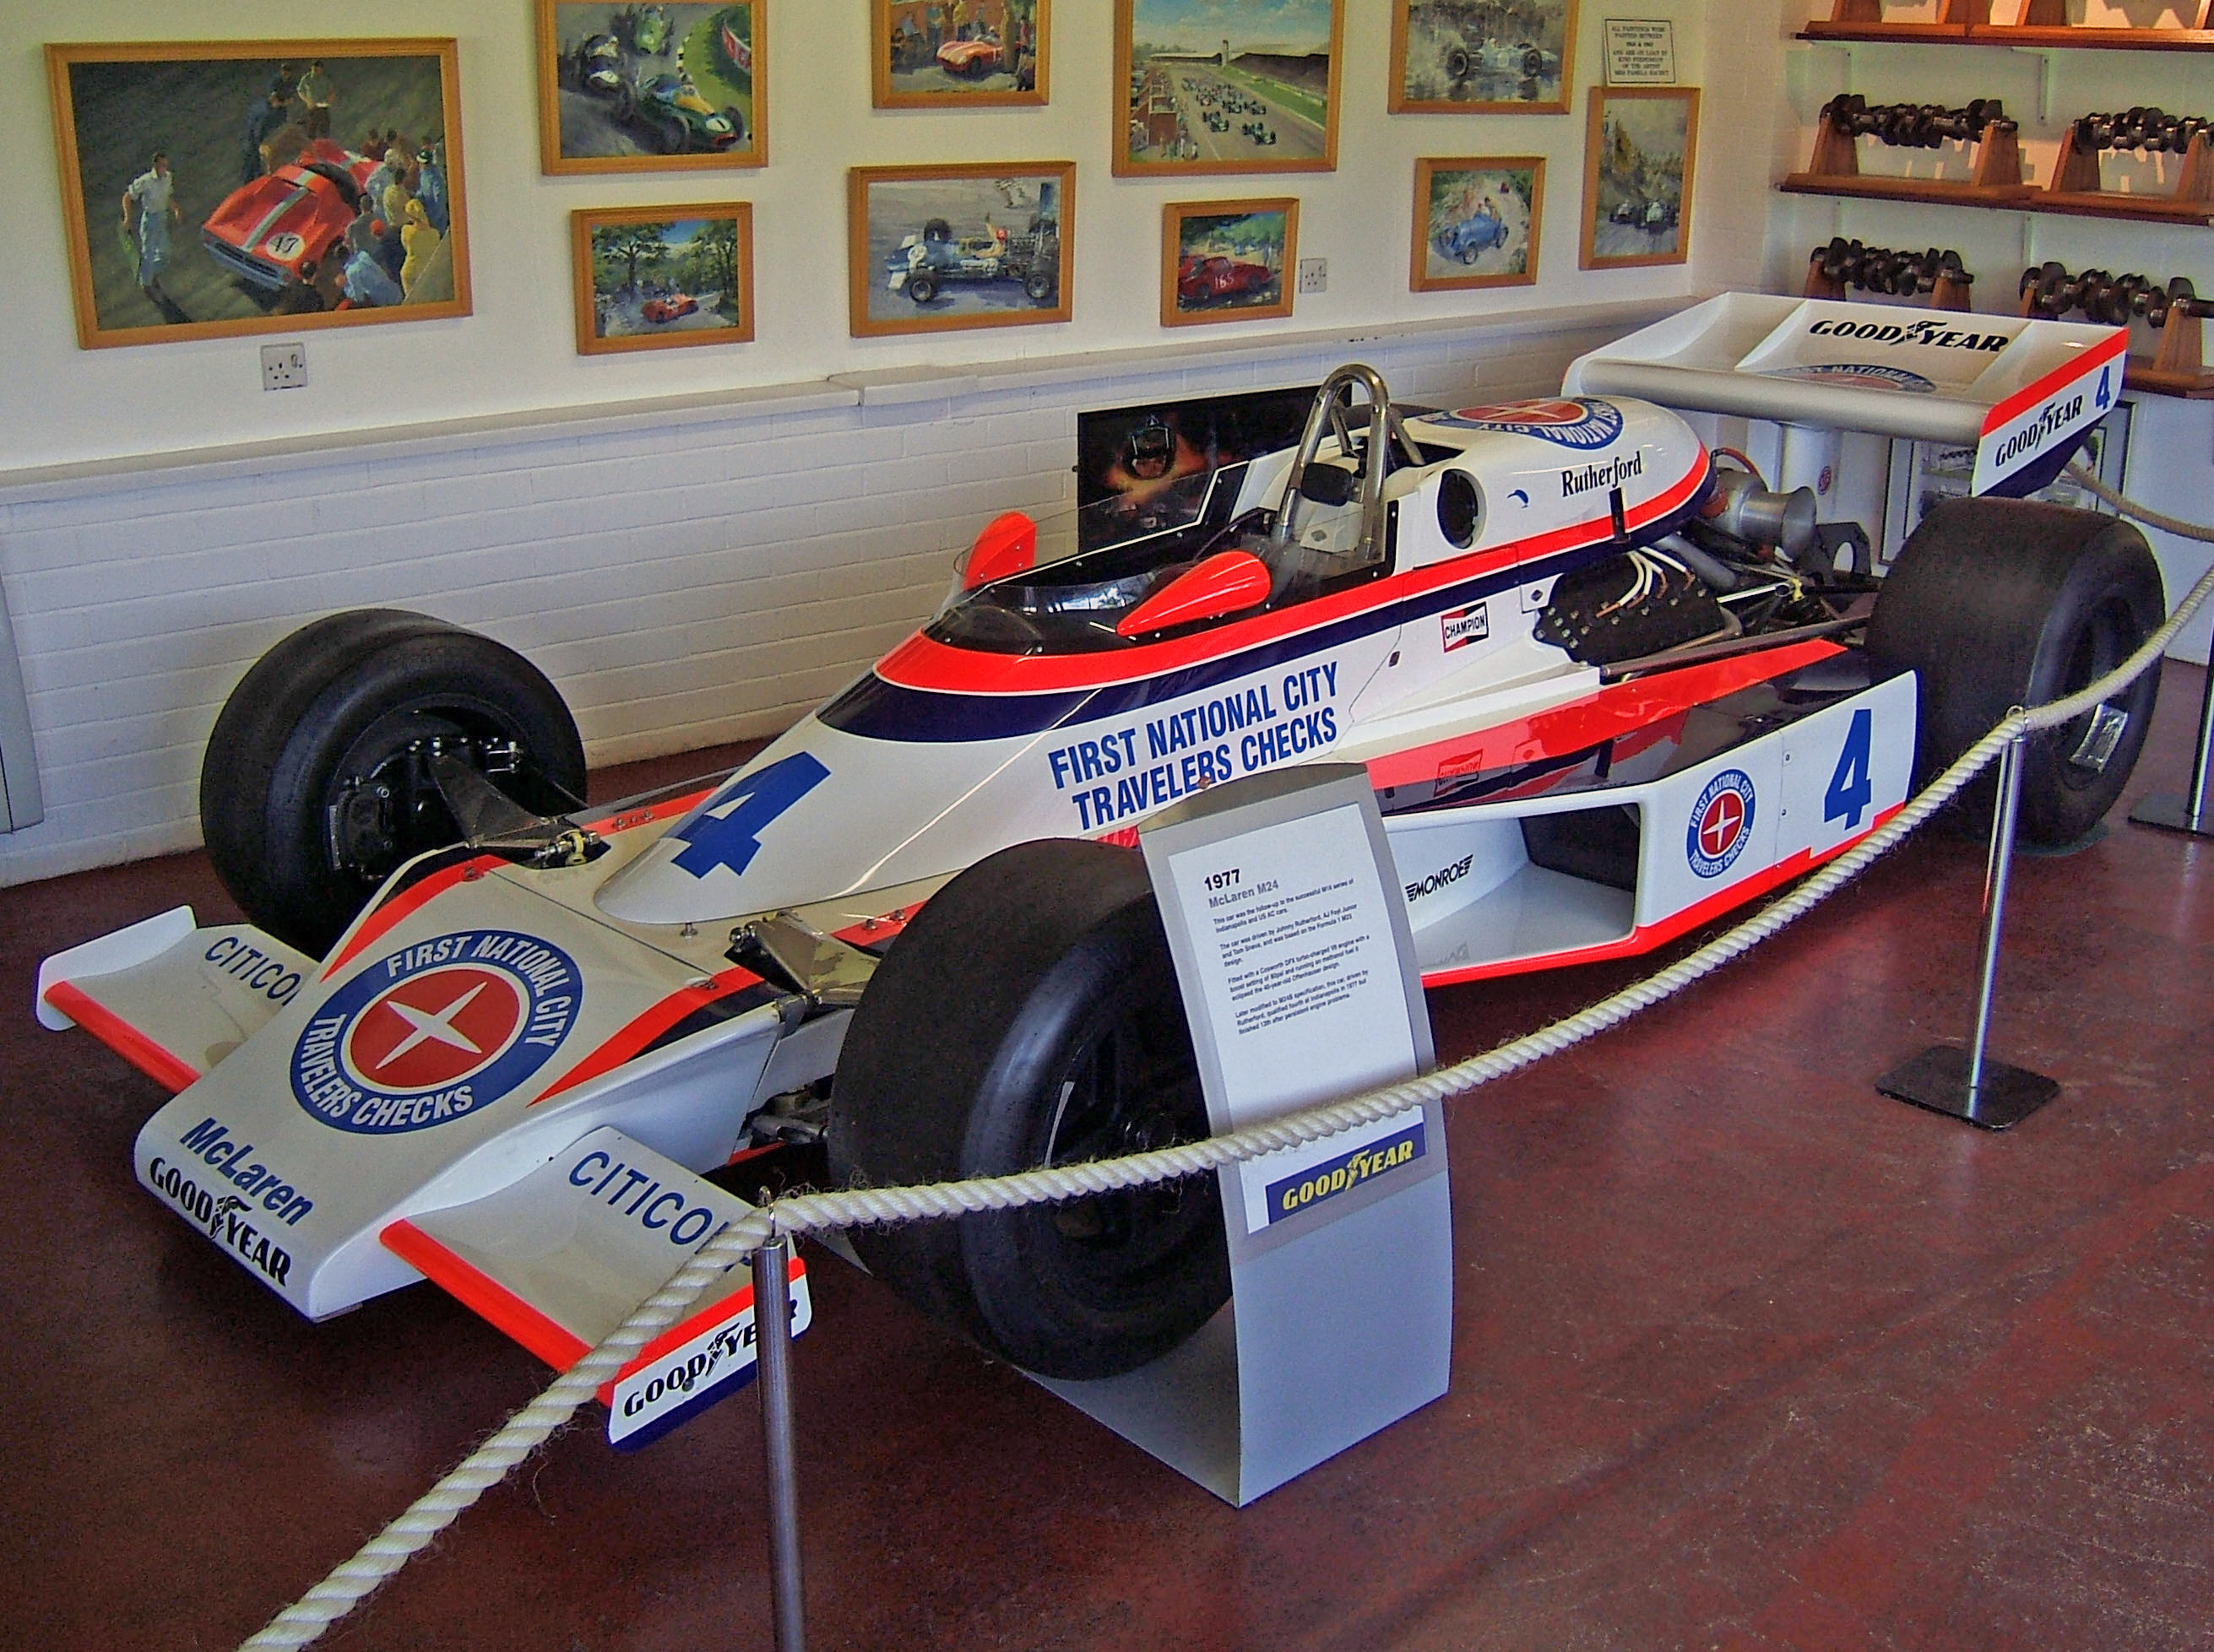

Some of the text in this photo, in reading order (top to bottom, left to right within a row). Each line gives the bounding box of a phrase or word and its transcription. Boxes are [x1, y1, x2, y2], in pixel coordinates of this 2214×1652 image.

[1810, 321, 2009, 352] GOODYEAR
[2096, 366, 2110, 410] 4
[1995, 395, 2082, 467] GOODYEAR
[1561, 450, 1642, 497] Rutherford
[1445, 615, 1485, 639] CHAMPION
[1048, 661, 1338, 789] FIRST NATIONAL CITY
[1072, 707, 1338, 830] TRAVELERS CHECKS
[1690, 794, 1708, 828] FIRST
[1739, 780, 1753, 803] CITY
[1824, 708, 1871, 831] 4
[670, 751, 832, 880] 4
[1723, 826, 1750, 867] CHECKS
[1204, 868, 1240, 891] 1977
[1209, 880, 1279, 908] McLaren M24
[1405, 854, 1473, 902] MONROE
[1216, 920, 1247, 934] Indianapolis
[1258, 913, 1267, 921] US
[1222, 951, 1232, 959] and
[1251, 931, 1267, 941] driven
[204, 936, 302, 1007] CITICO
[387, 935, 572, 1047] FIRST NATIONAL CITY
[301, 1014, 474, 1127] TRAVELERS CHECKS
[179, 1117, 313, 1227] McLaren
[1283, 1140, 1414, 1211] GOODYEAR
[149, 1156, 291, 1286] GOODYEAR
[568, 1151, 752, 1272] CITICO
[623, 1298, 798, 1417] GOODYE
